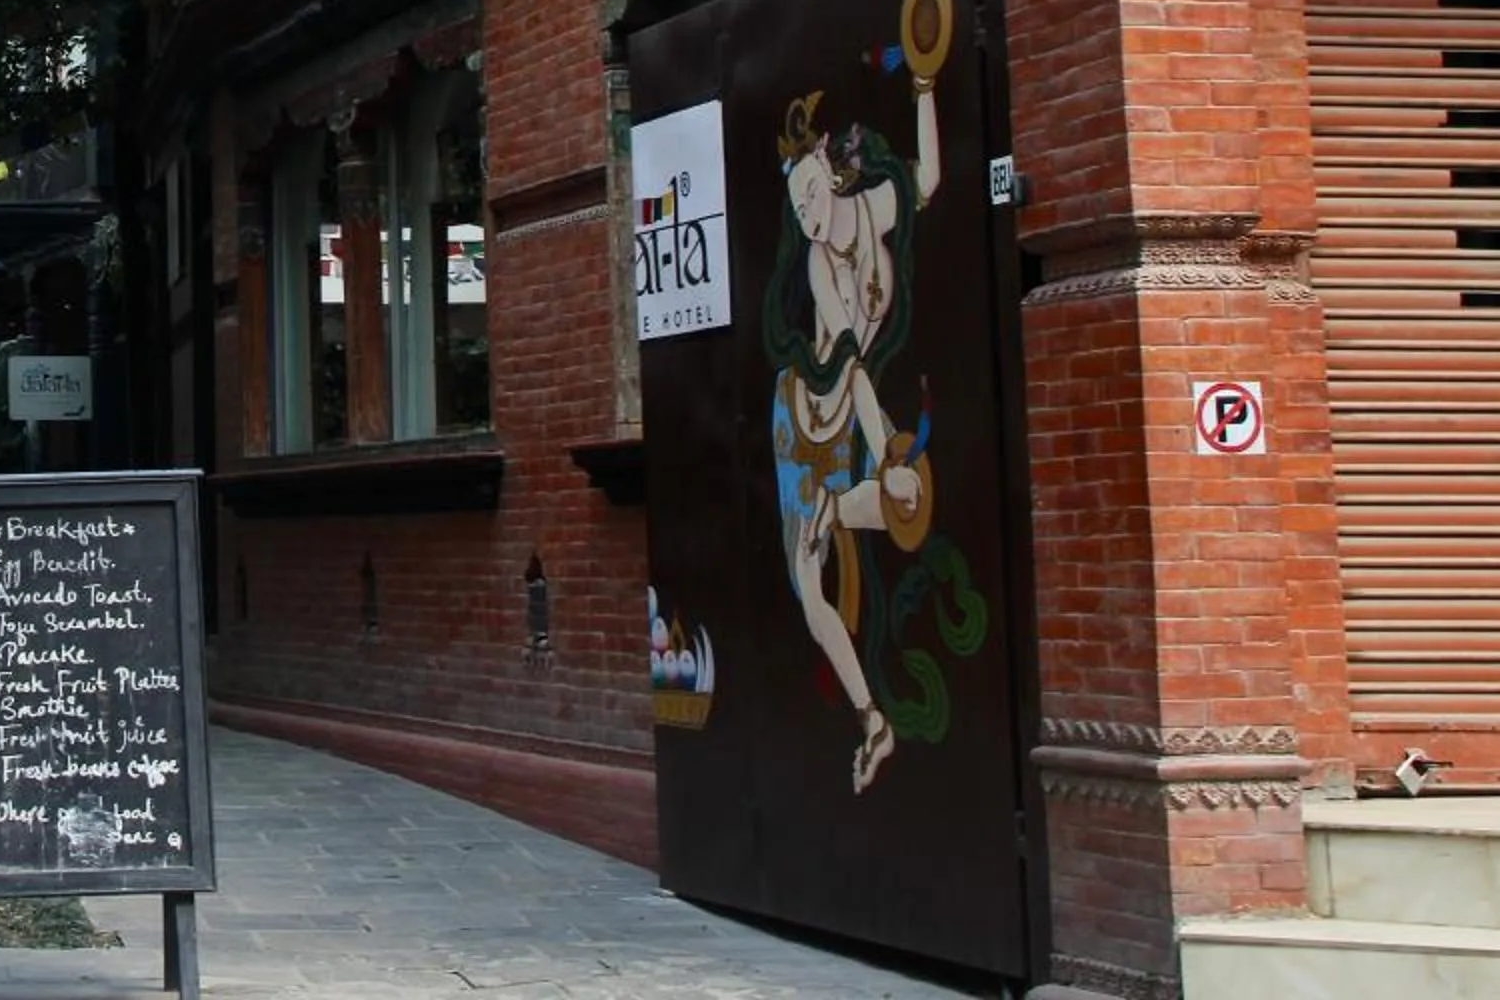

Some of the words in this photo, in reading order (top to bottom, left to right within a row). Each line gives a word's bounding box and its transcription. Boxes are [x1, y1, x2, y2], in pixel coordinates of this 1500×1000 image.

[661, 305, 713, 330] HOTEL
[1216, 396, 1249, 442] P
[57, 668, 109, 697] Fruit
[1, 754, 59, 784] Fresh
